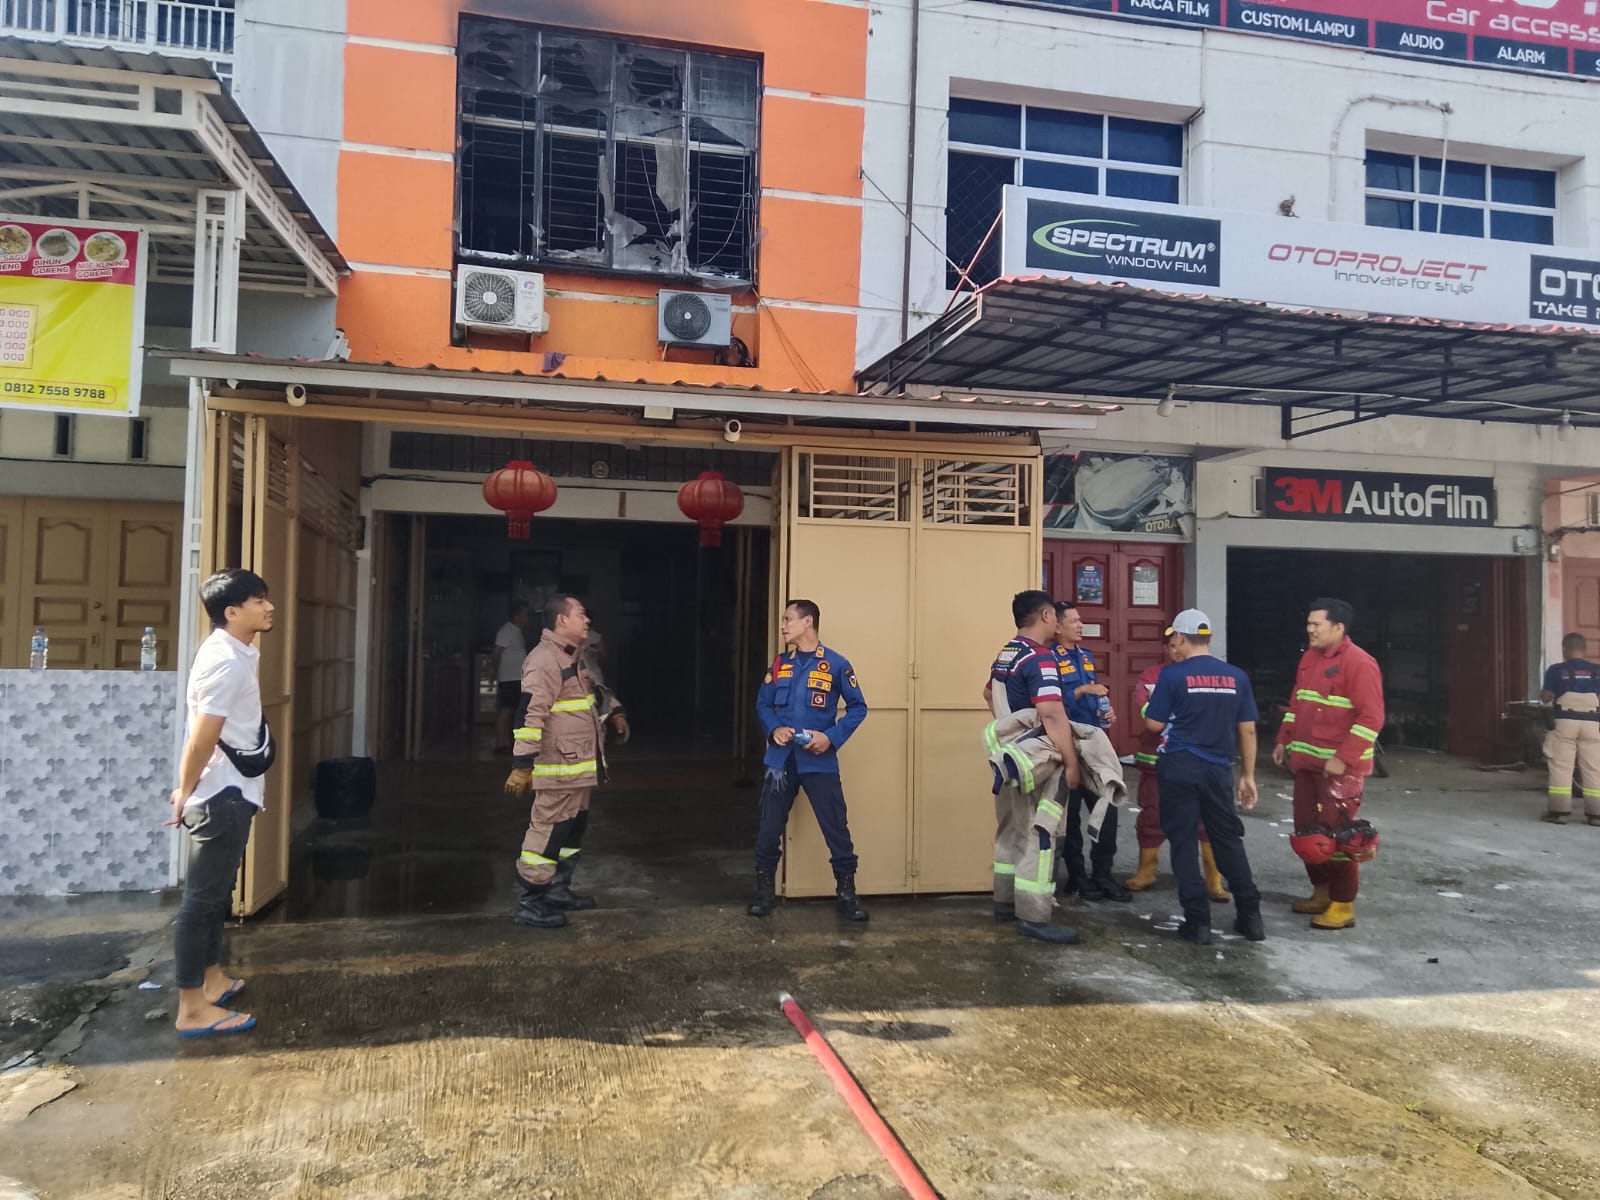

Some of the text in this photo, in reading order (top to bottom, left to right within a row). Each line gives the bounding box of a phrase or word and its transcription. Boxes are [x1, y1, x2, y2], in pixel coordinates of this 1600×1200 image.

[1176, 0, 1210, 18] FILM
[1426, 0, 1480, 26] Car
[1241, 9, 1356, 39] CUSTOM LAMPU
[1399, 32, 1444, 51] AUDIO
[1497, 45, 1546, 65] ALARM
[1105, 254, 1207, 274] WINDOW FILM
[1267, 244, 1488, 281] OTOPROJECT
[1334, 269, 1409, 287] Innovate
[1411, 278, 1431, 290] for
[1532, 301, 1588, 318] TAKE
[4, 382, 106, 399] 0812 7558 9788
[1273, 476, 1488, 520] 3M AutoFilm
